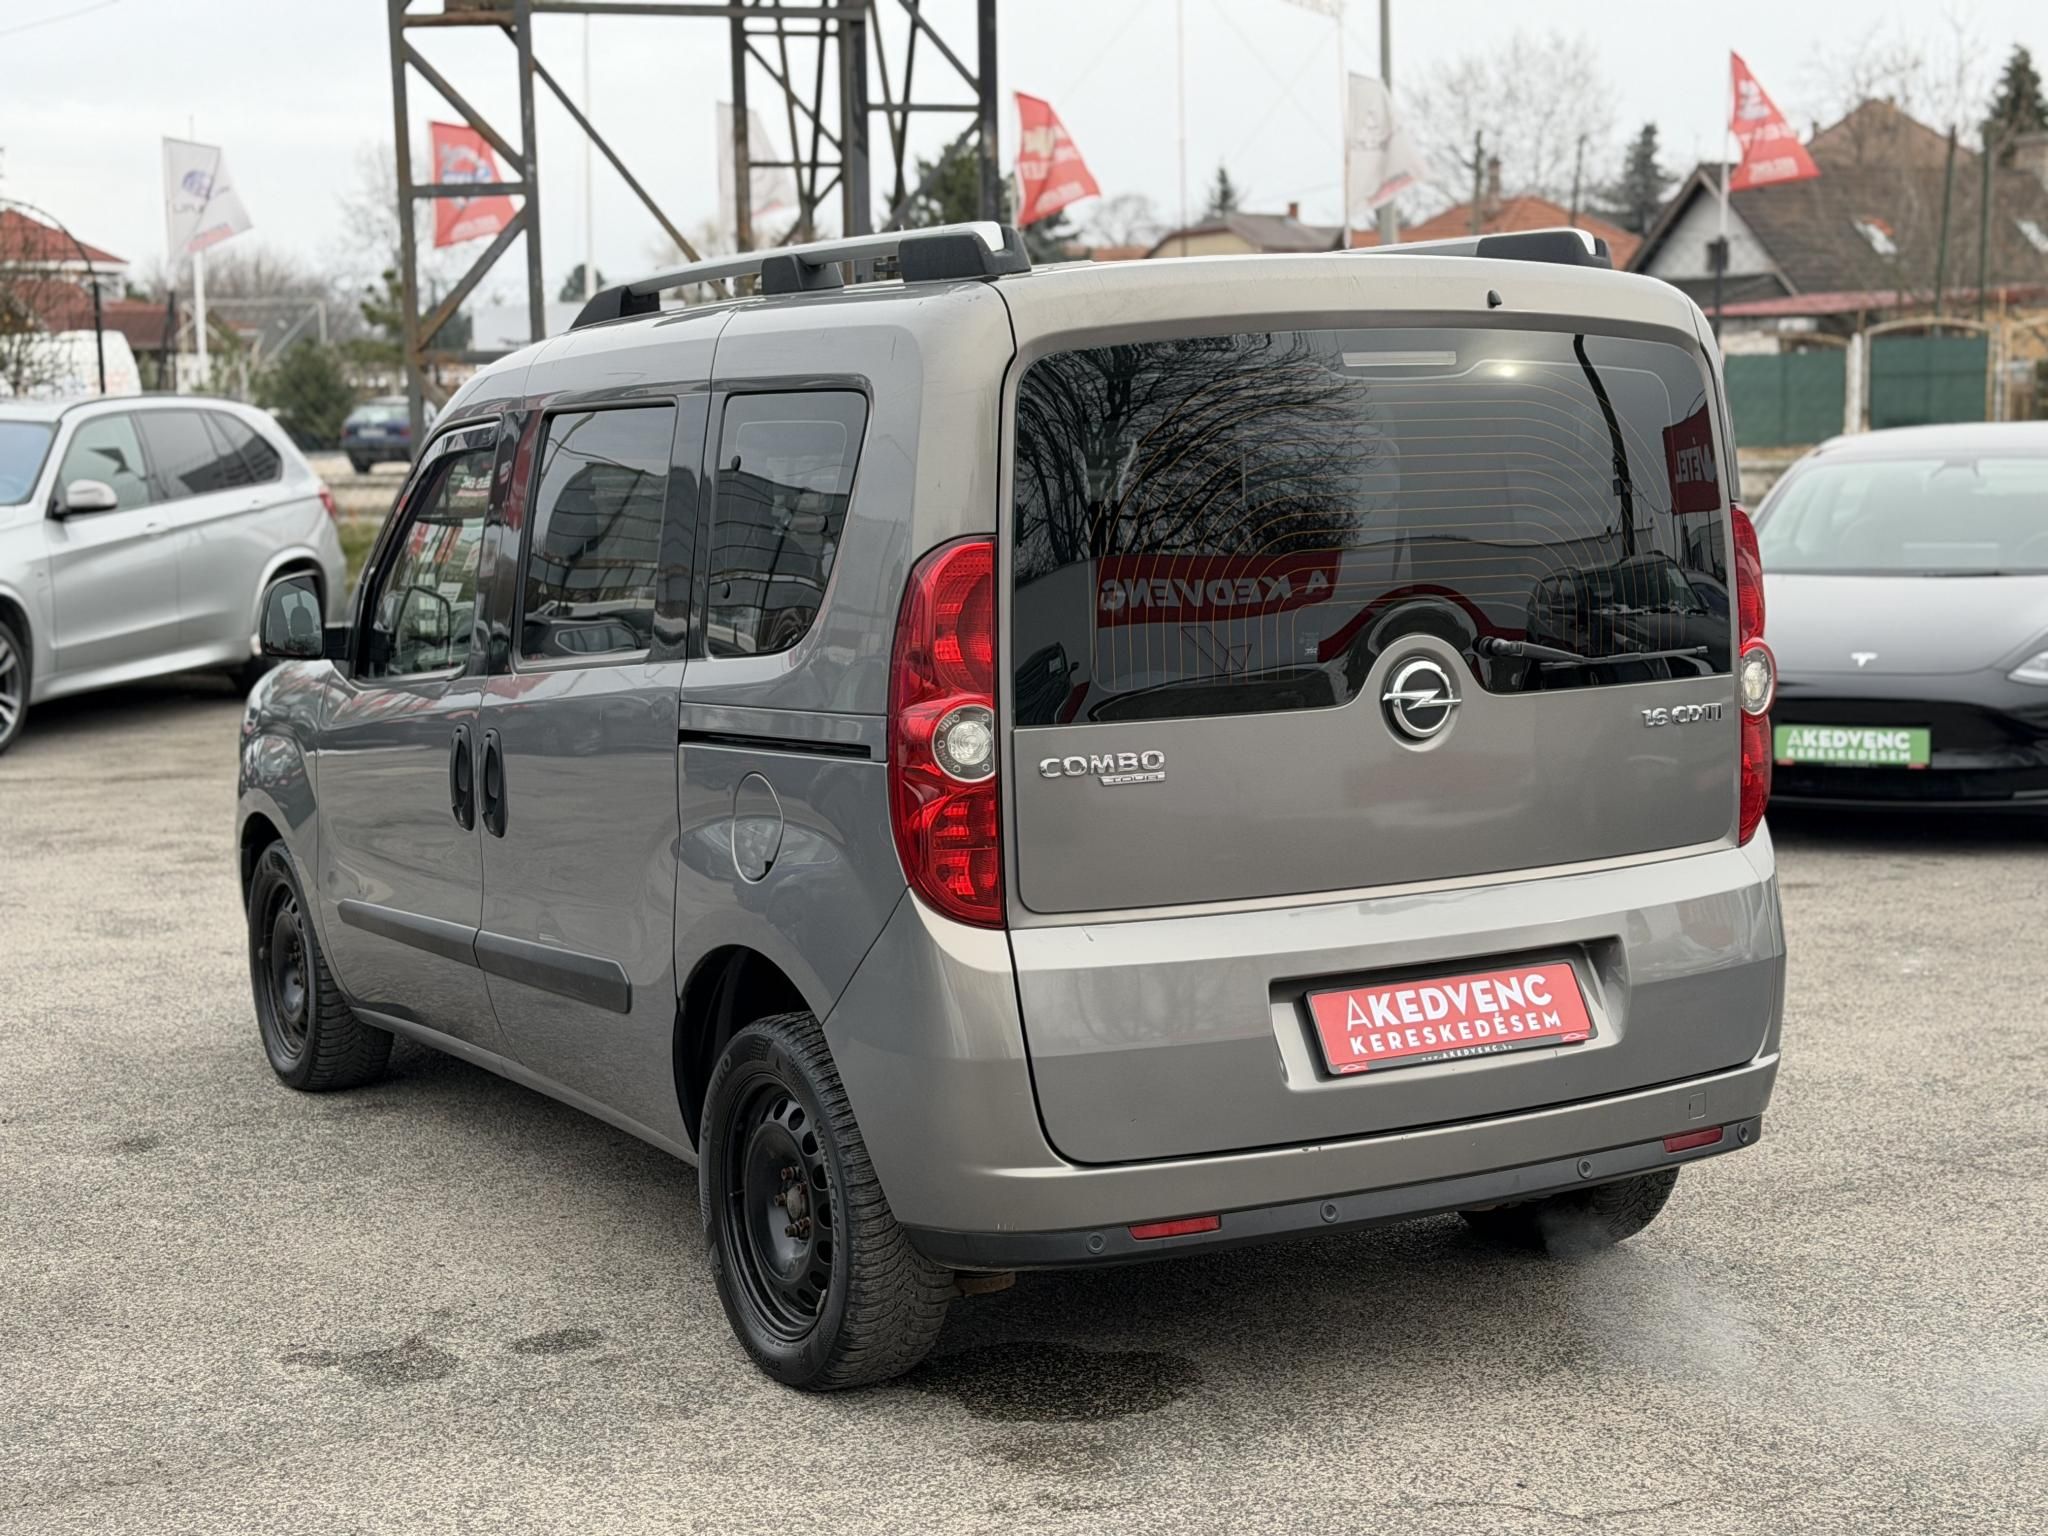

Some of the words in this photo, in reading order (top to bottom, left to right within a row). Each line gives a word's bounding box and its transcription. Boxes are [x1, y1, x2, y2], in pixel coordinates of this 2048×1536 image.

[1039, 750, 1165, 777] COMBO
[1346, 973, 1553, 1031] AKEDVENC
[1349, 1010, 1562, 1055] KERESKEDÉSEM
